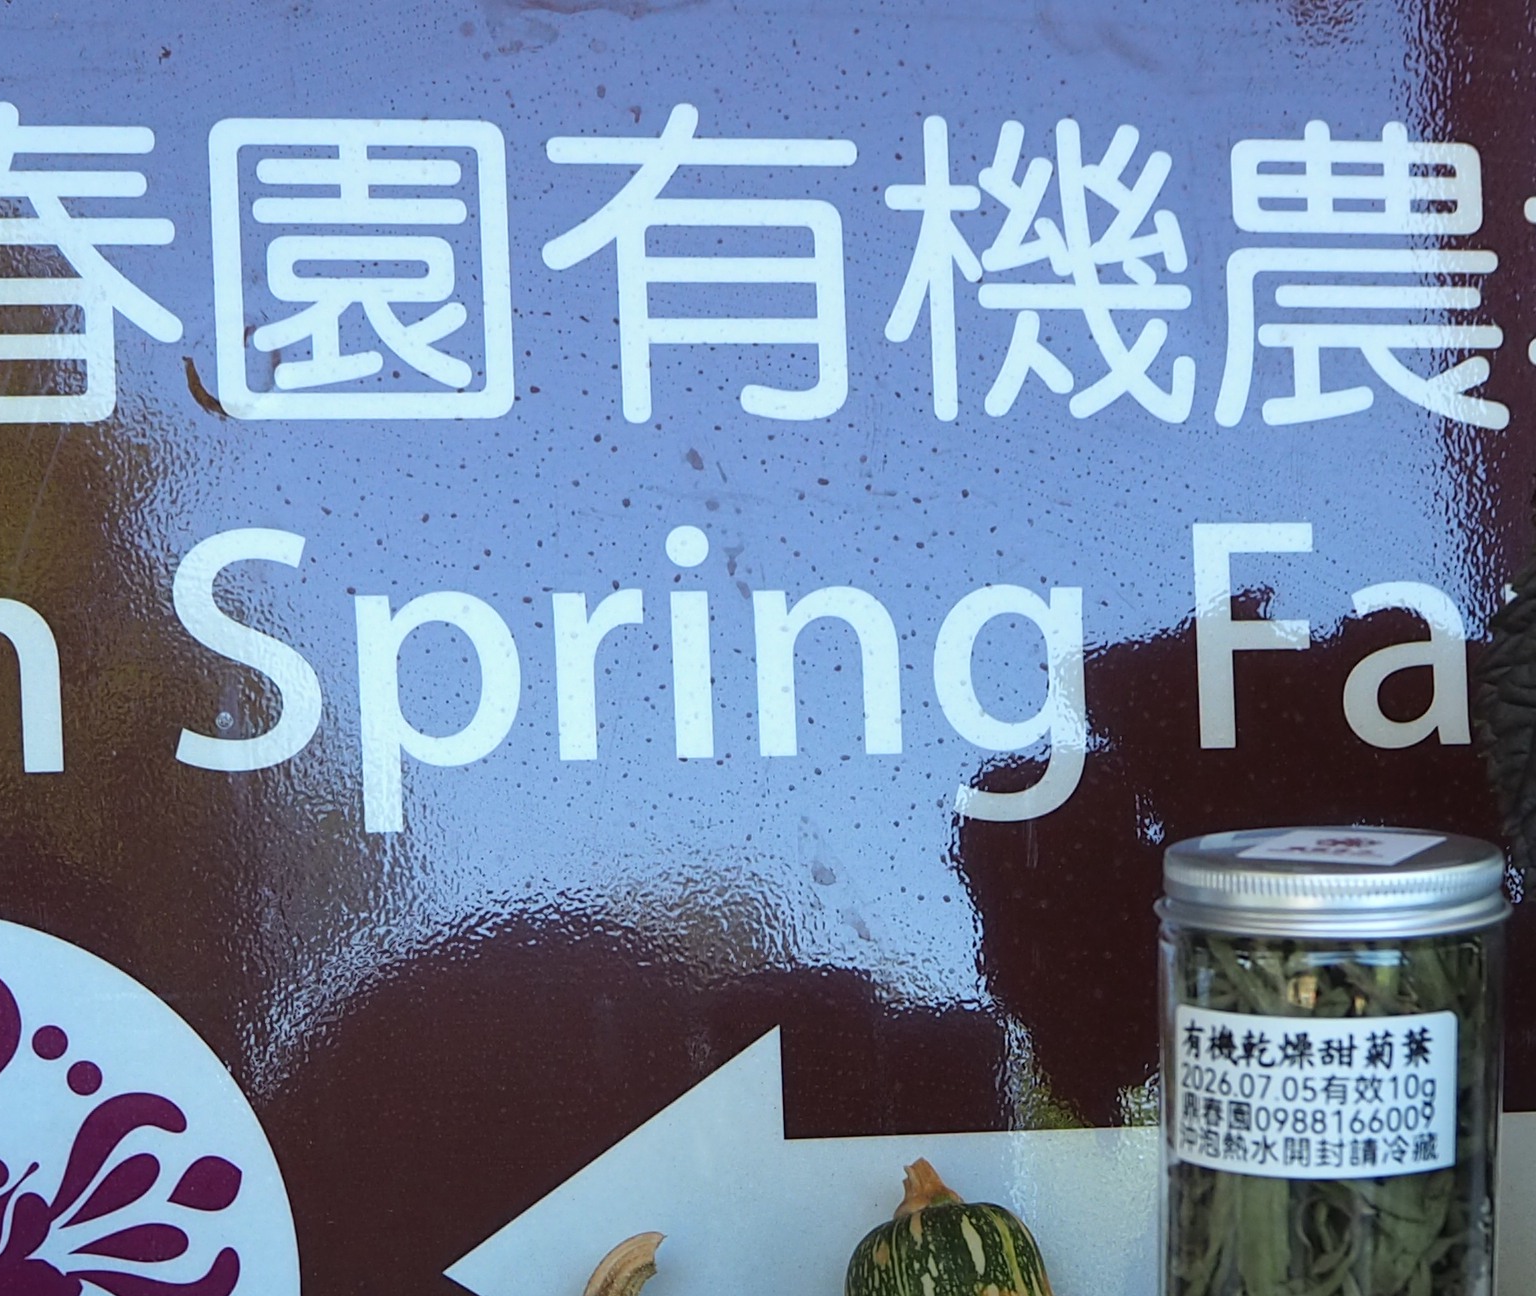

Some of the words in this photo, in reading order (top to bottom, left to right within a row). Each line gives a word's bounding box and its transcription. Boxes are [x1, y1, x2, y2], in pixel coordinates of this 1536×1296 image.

[174, 525, 1086, 834] Spring
[1192, 522, 1519, 750] Fa
[1182, 1019, 1433, 1070] 有機乾燥甜菊葉
